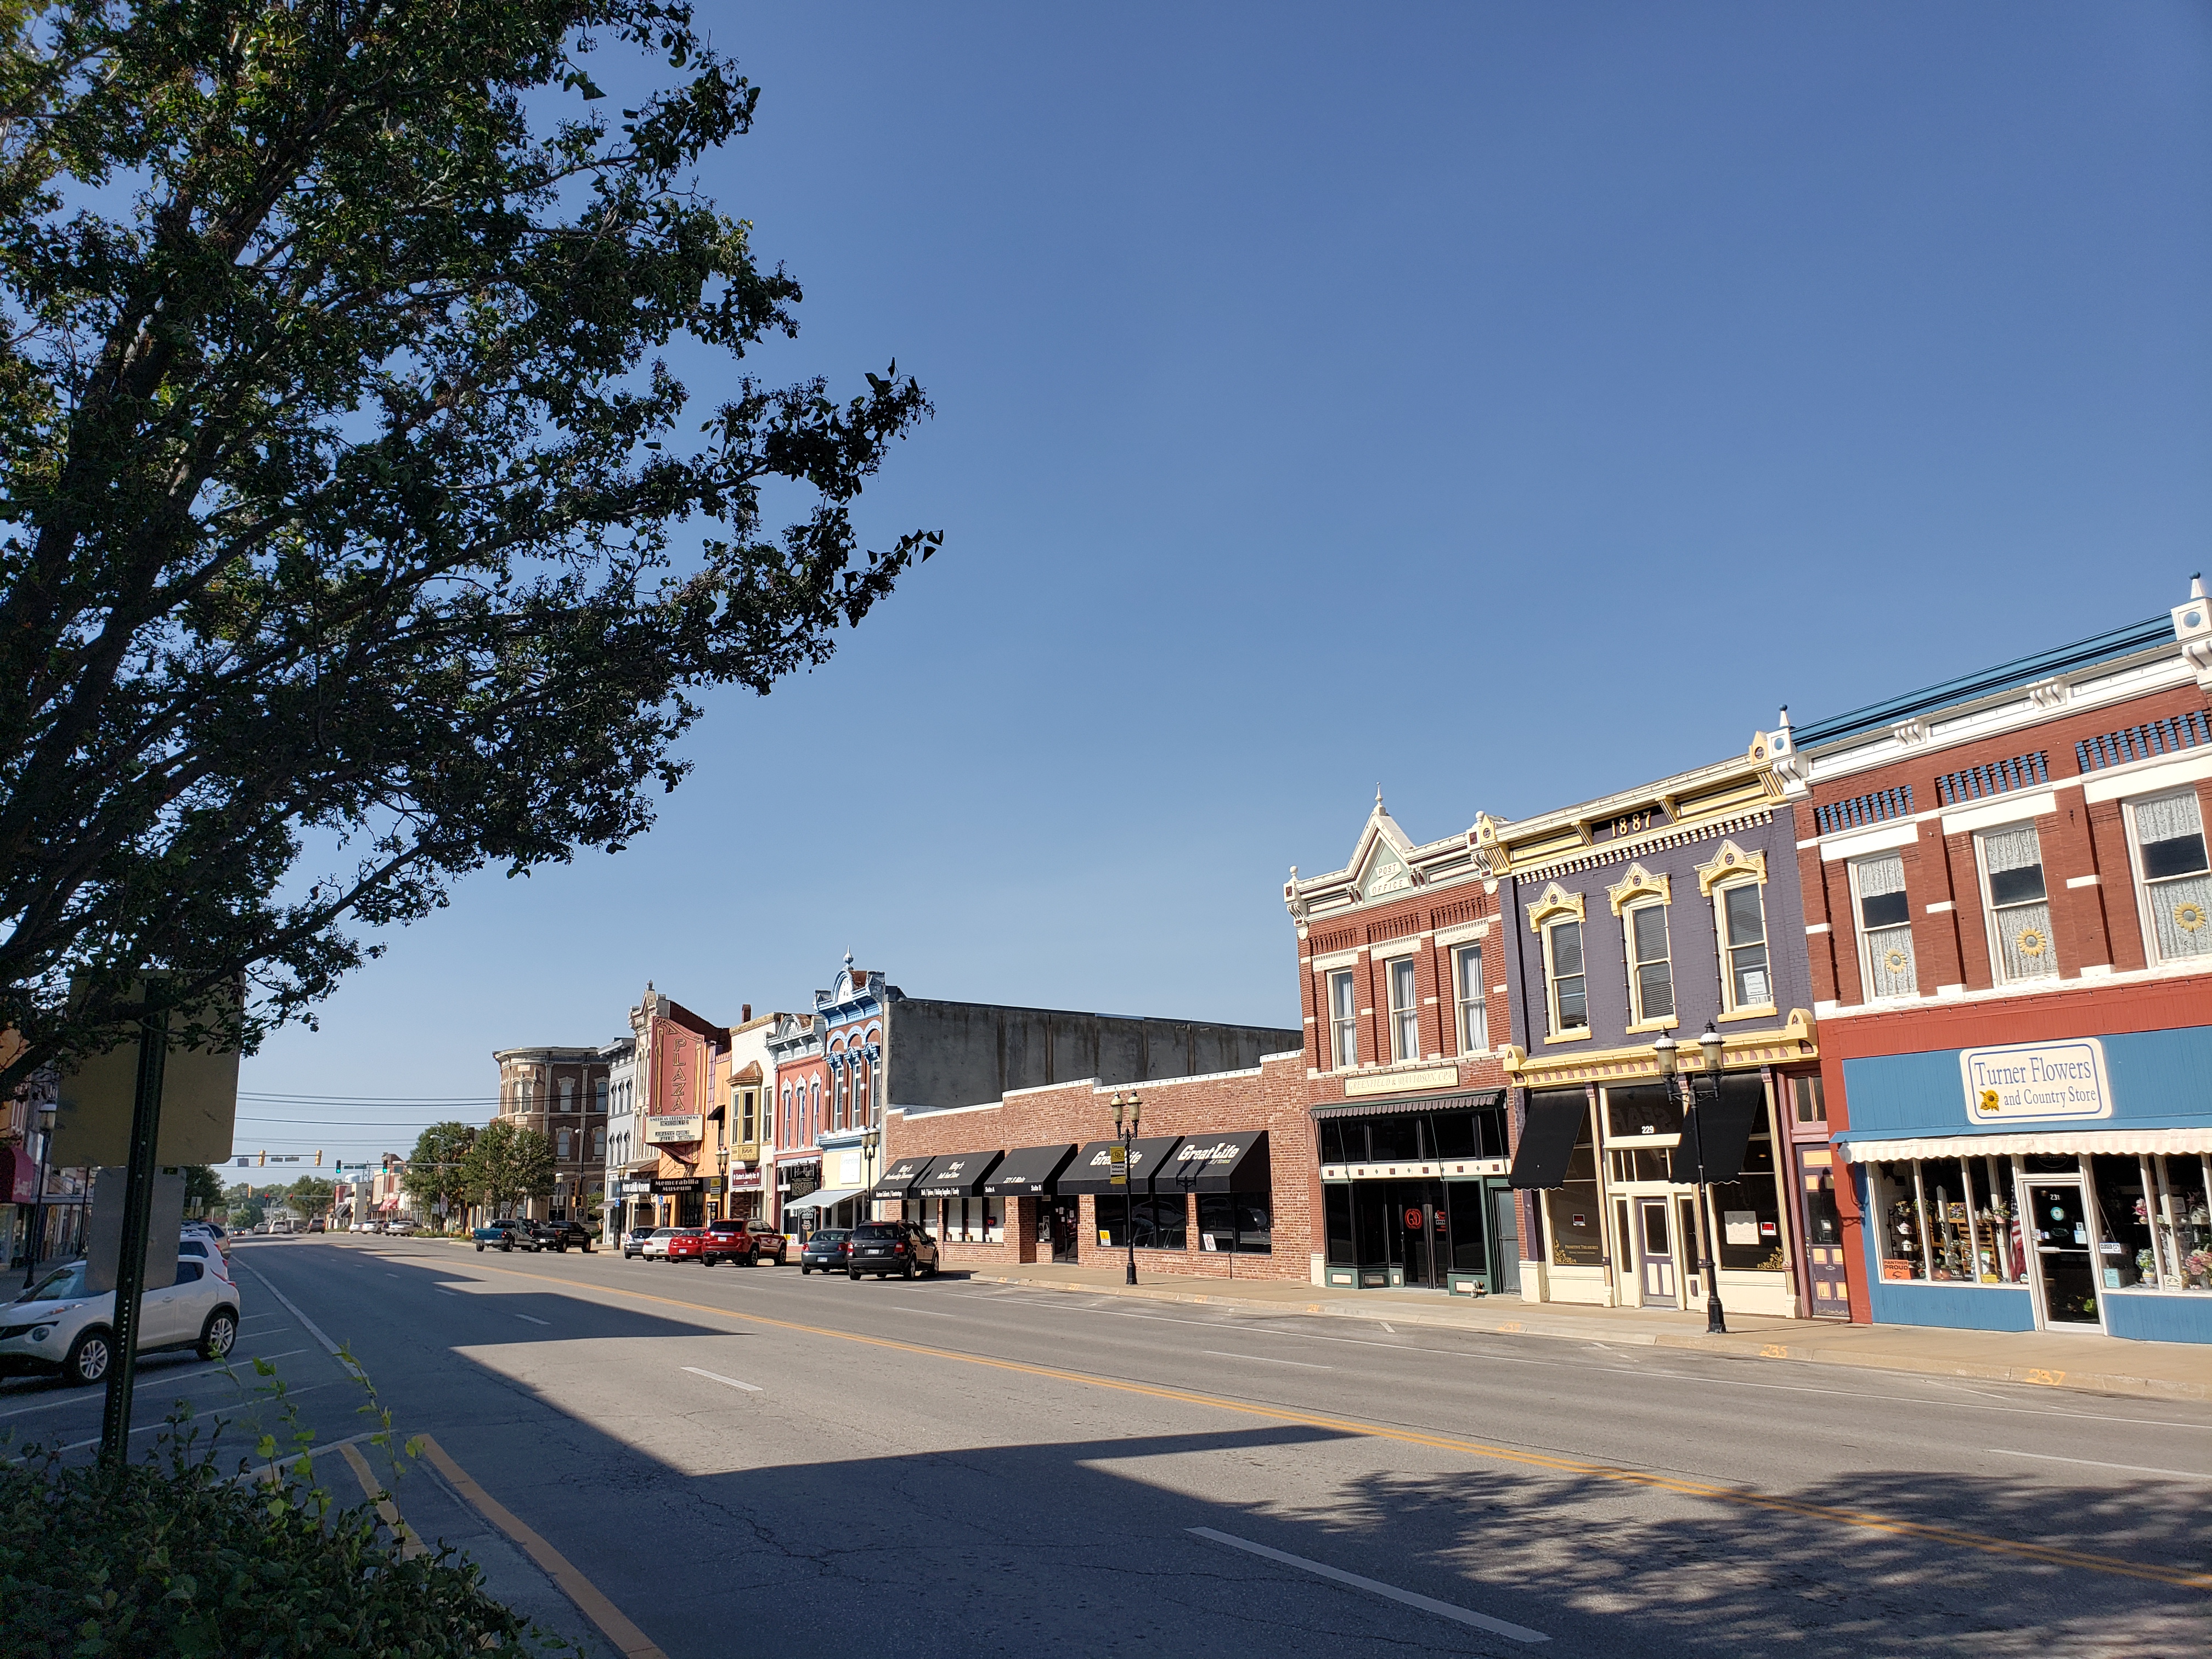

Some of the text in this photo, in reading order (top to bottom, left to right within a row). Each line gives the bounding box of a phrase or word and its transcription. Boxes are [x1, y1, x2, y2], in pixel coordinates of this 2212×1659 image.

[1611, 810, 1651, 837] 1887
[670, 1038, 686, 1111] PLAZA
[1348, 1077, 1390, 1092] GREENFIELD
[1438, 1070, 1455, 1081] CPAs
[1974, 1057, 2091, 1086] Turner Flowers
[2004, 1086, 2096, 1108] and Country Store
[1641, 1125, 1654, 1134] 229
[654, 1178, 699, 1187] Memorabilia
[1759, 1344, 1788, 1359] 235
[2025, 1368, 2066, 1386] 237
